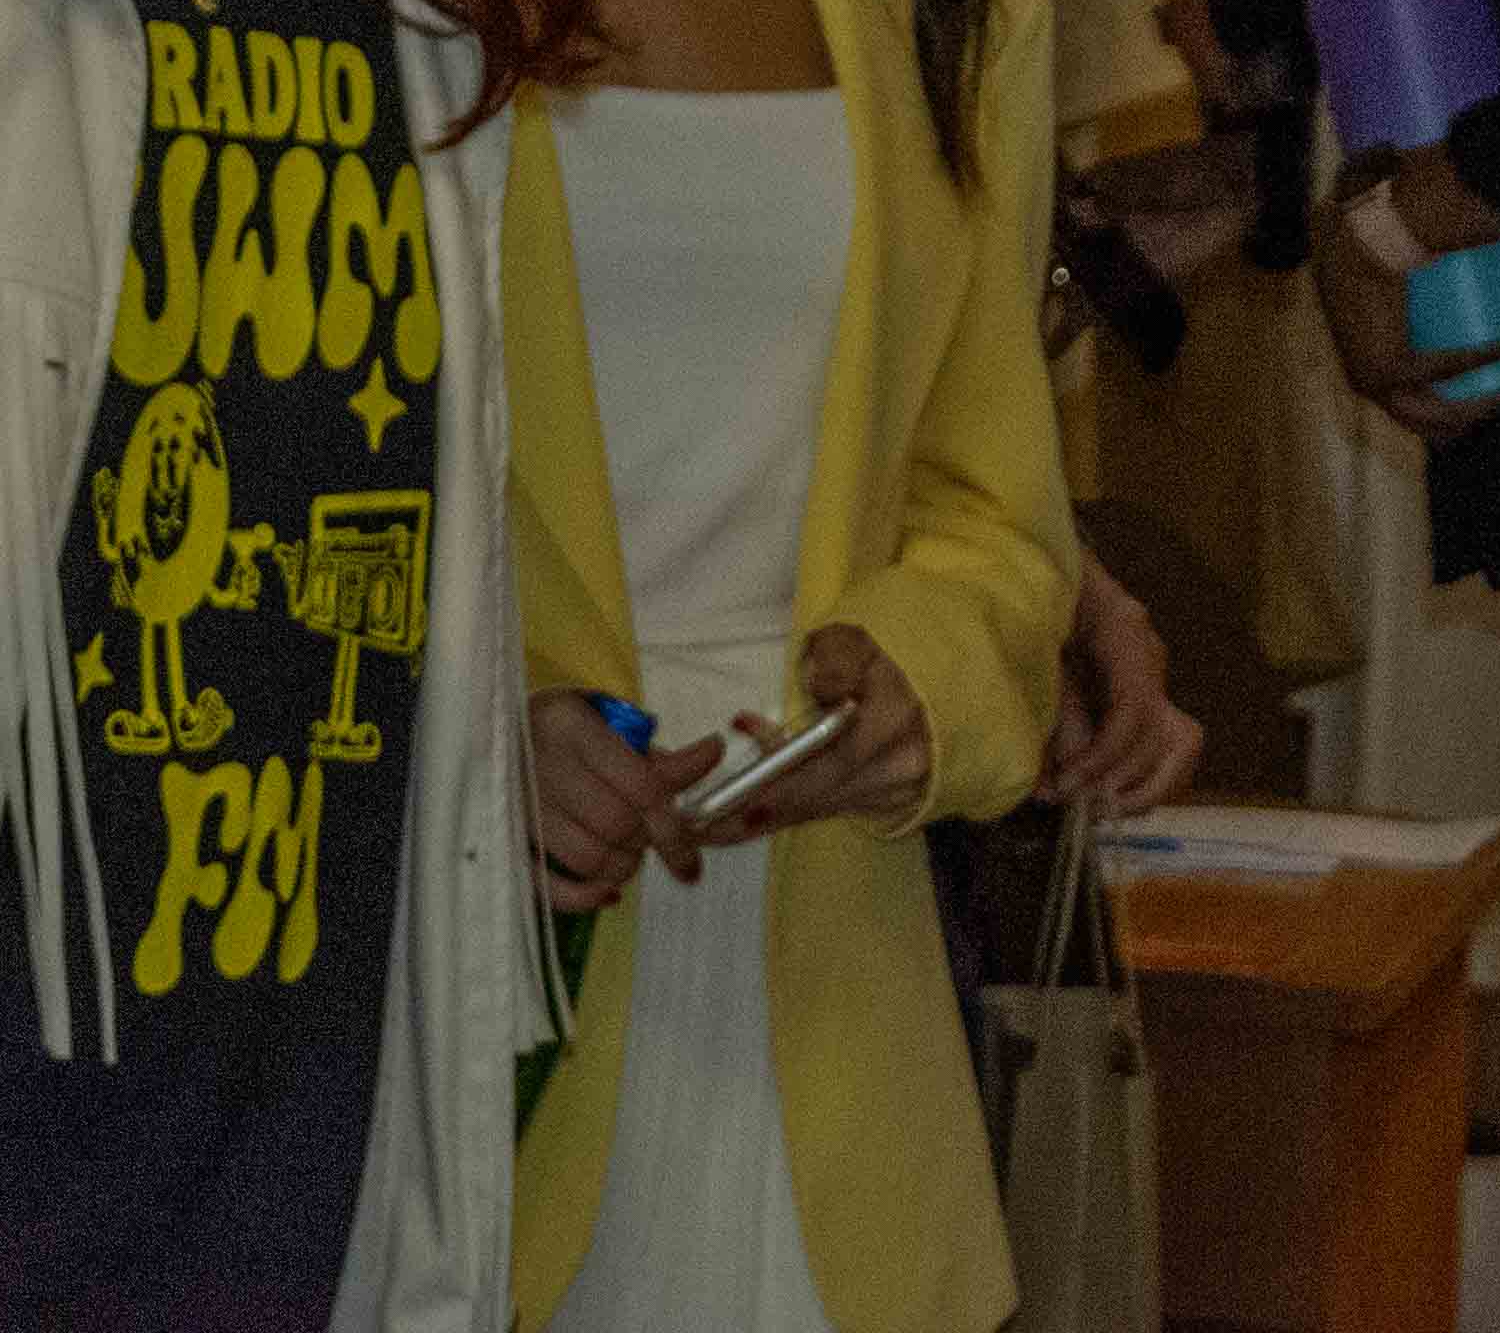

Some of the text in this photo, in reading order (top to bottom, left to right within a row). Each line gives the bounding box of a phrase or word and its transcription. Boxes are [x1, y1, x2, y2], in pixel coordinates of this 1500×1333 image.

[146, 20, 377, 150] RADIO
[109, 133, 443, 387] UWM
[132, 755, 325, 996] FM
